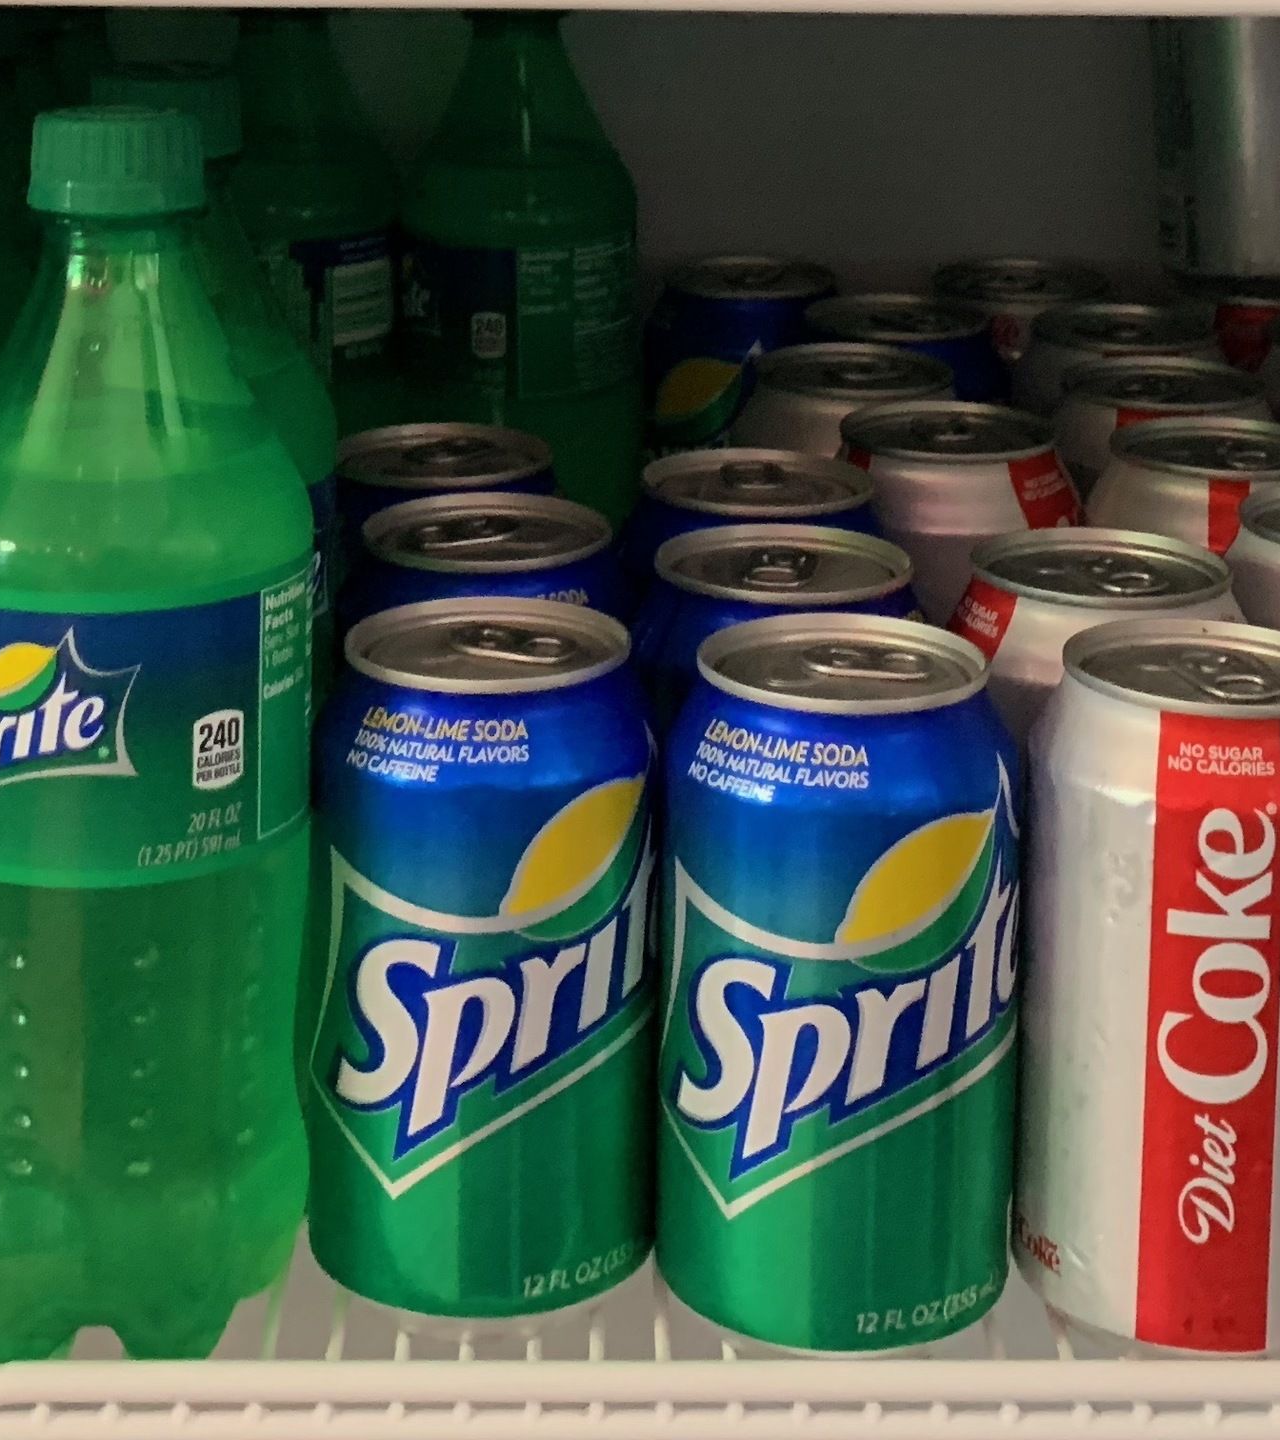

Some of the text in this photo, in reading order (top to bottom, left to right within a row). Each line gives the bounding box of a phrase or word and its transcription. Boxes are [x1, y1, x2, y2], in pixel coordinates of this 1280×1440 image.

[199, 717, 240, 754] 240
[362, 706, 529, 742] LEMON-LIME SODA
[197, 748, 241, 768] CALORIES
[354, 728, 530, 764] 100% NATURAL FLAVORS
[705, 718, 869, 767] LEMON-LIME SODA
[1180, 741, 1263, 761] NO SUGAR
[197, 763, 241, 784] PER BOTTLE
[346, 749, 439, 782] NO CAFFEINE
[688, 761, 775, 803] NO CAFFEINE
[696, 740, 869, 789] 100% NATURAL FLAVORS
[1167, 754, 1276, 776] NO CALORIES
[187, 812, 205, 834] 20
[138, 843, 172, 867] (1.25
[173, 836, 198, 863] PT)
[1157, 807, 1278, 1104] Coke
[1178, 1113, 1238, 1245] Diet
[523, 1256, 602, 1298] 12 FL OZ
[856, 1313, 879, 1334] 12
[884, 1309, 906, 1331] FL
[912, 1302, 940, 1327] OZ
